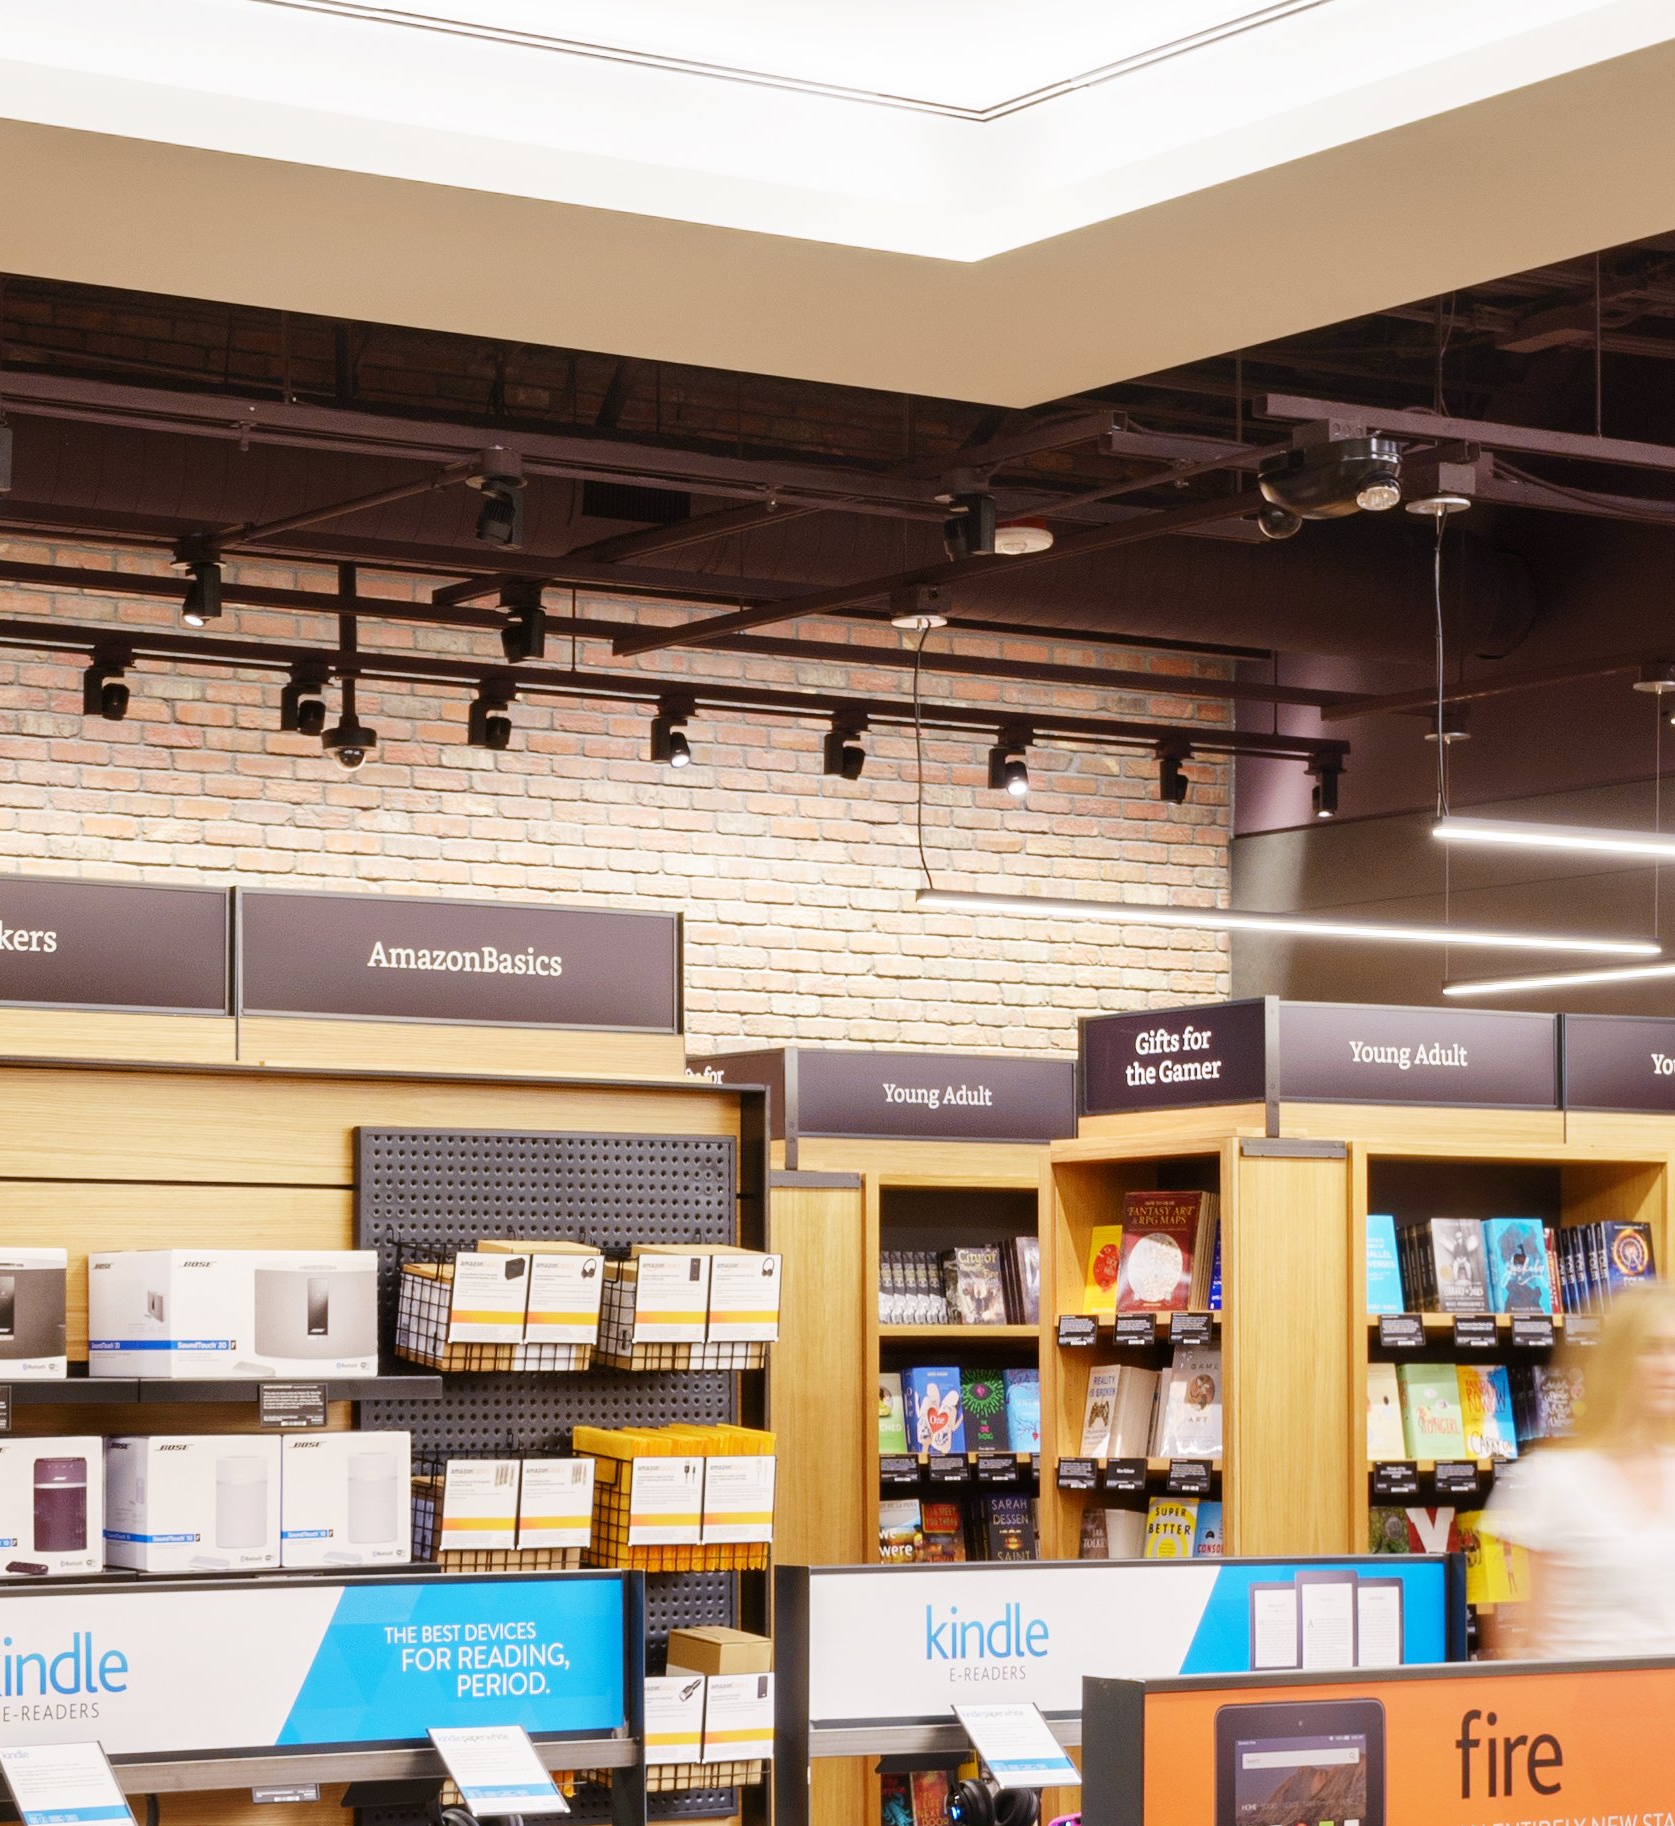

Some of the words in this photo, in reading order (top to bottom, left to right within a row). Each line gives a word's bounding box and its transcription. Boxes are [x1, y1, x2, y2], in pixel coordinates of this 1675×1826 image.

[367, 940, 564, 981] AmazonBasics
[1135, 1032, 1179, 1056] Gifts
[1182, 1028, 1211, 1053] for
[1349, 1041, 1410, 1070] Young
[1413, 1042, 1467, 1069] Adult
[1127, 1059, 1156, 1084] the
[1161, 1055, 1222, 1082] Gamer
[883, 1081, 939, 1111] Young
[942, 1083, 992, 1107] Adult
[992, 1499, 1028, 1510] SARAH
[1156, 1507, 1187, 1518] SUPER
[993, 1513, 1029, 1525] DESSEN
[1148, 1523, 1191, 1534] BETTER
[384, 1625, 418, 1644] THE
[421, 1624, 460, 1643] BEST
[464, 1622, 537, 1642] DEVICES
[926, 1604, 1049, 1661] kindle
[401, 1647, 453, 1672] FOR
[459, 1643, 570, 1671] READING,
[456, 1667, 550, 1698] PERIOD.
[950, 1664, 1027, 1683] E-READERS
[3, 1702, 100, 1723] E-READERS
[1454, 1709, 1563, 1799] fire
